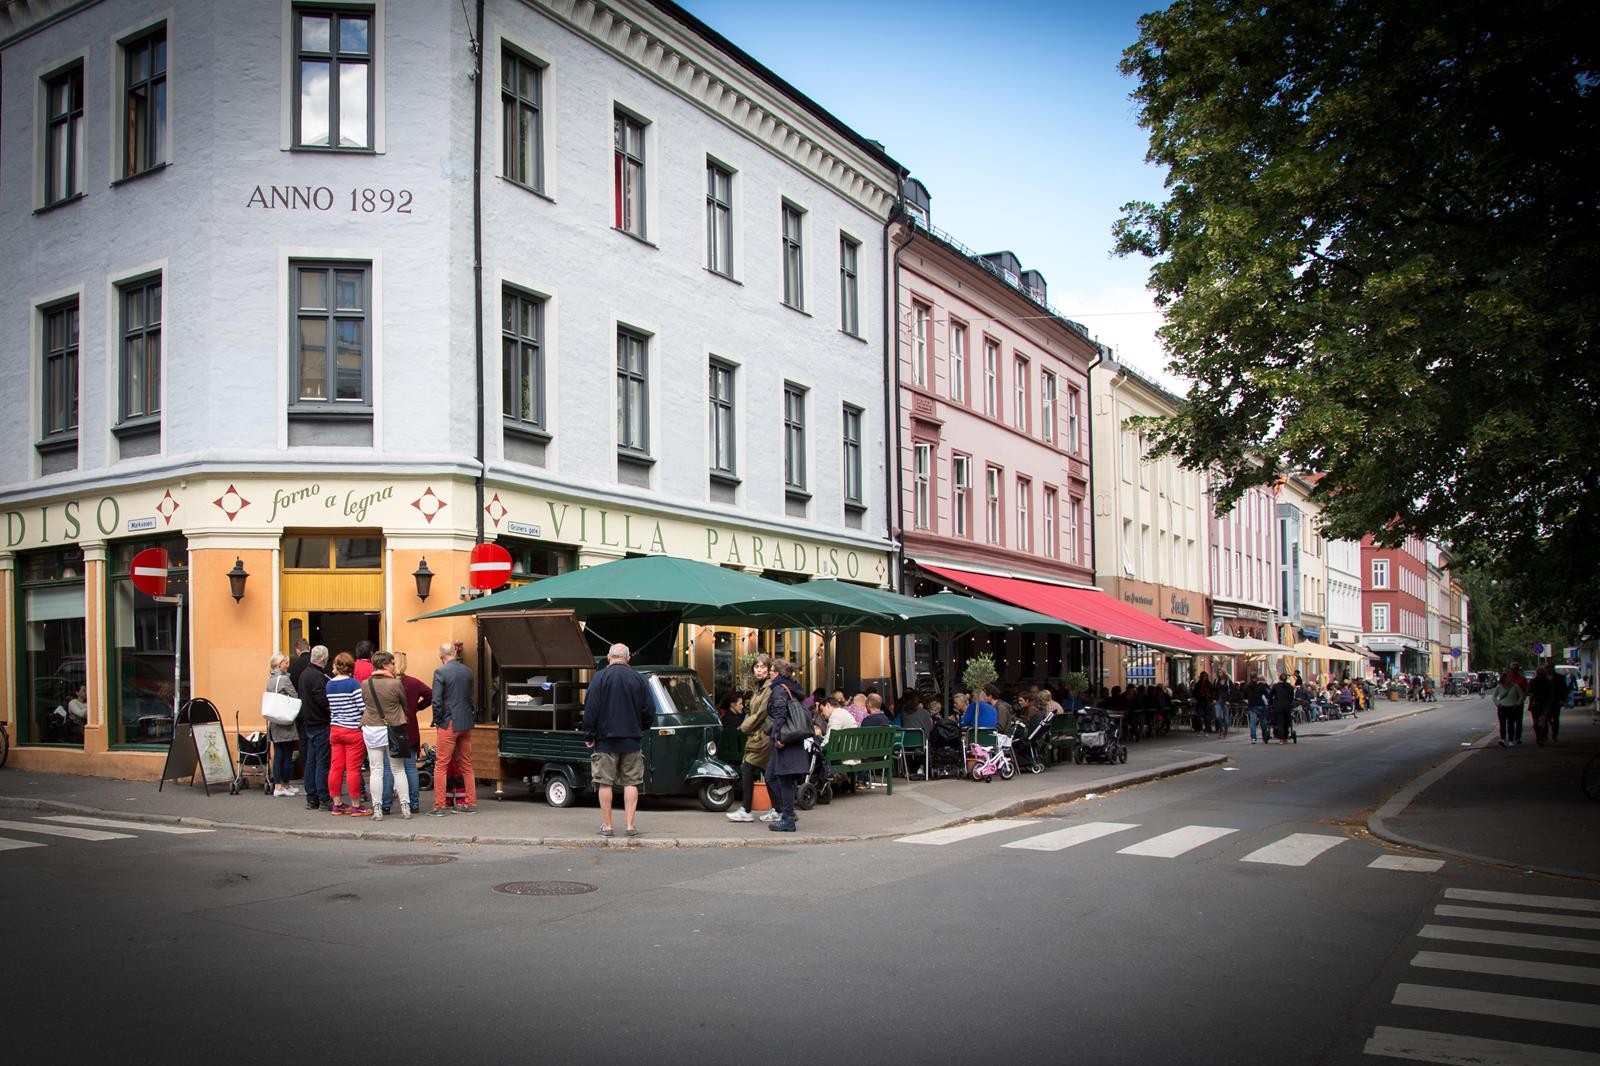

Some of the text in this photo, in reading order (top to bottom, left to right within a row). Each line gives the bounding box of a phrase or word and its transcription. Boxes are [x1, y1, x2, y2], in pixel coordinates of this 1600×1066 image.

[246, 185, 413, 214] ANNO 1892
[5, 496, 120, 547] DISO
[266, 483, 393, 523] forno a legna
[547, 502, 860, 579] VILLA PARADISO
